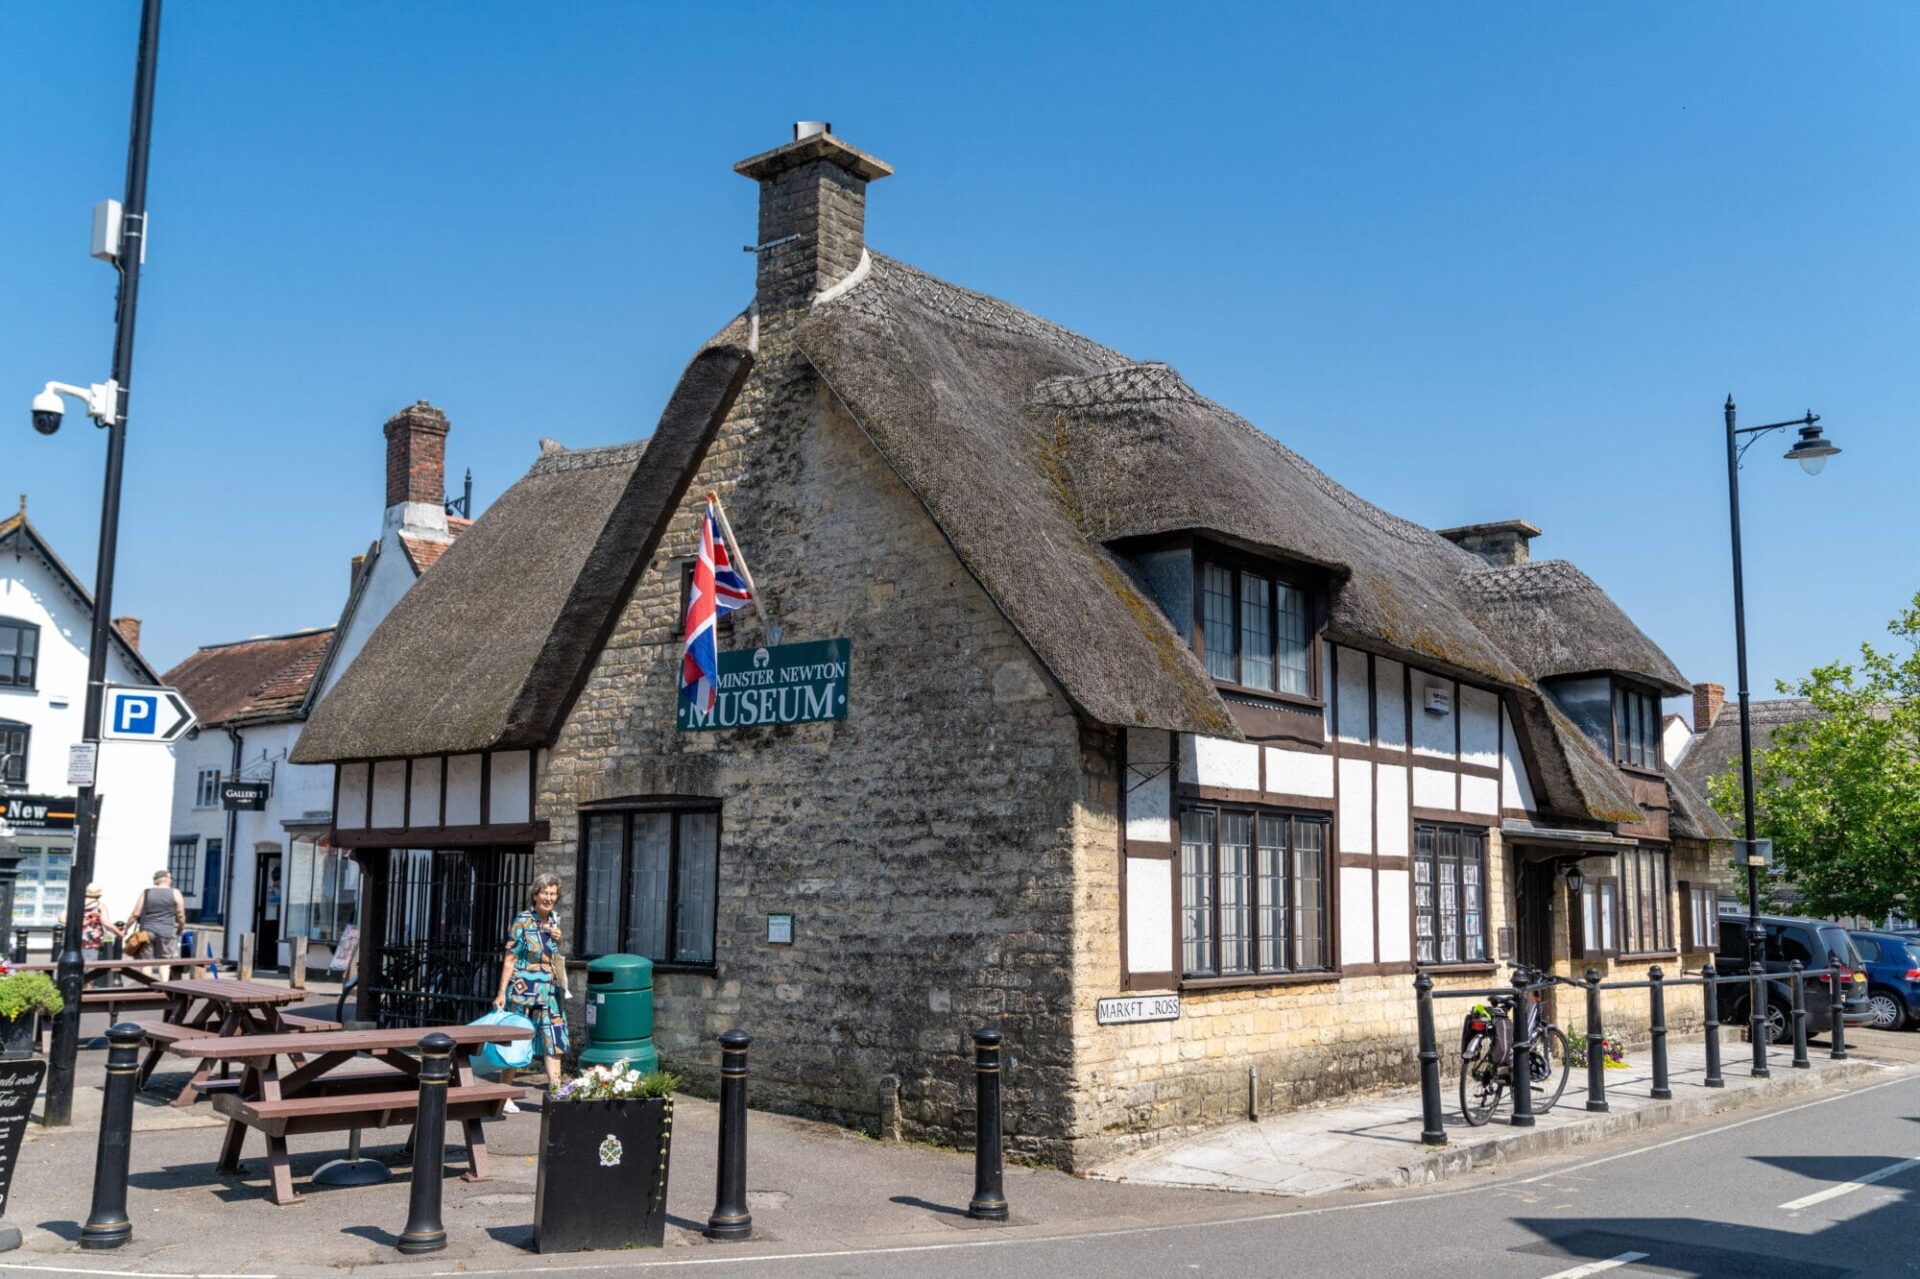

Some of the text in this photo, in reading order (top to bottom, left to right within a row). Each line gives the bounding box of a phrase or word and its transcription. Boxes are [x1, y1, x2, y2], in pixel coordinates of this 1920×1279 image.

[717, 662, 846, 688] MINSTER NEWTON
[122, 699, 149, 730] P
[687, 682, 836, 728] MUSEUM
[7, 800, 48, 819] New
